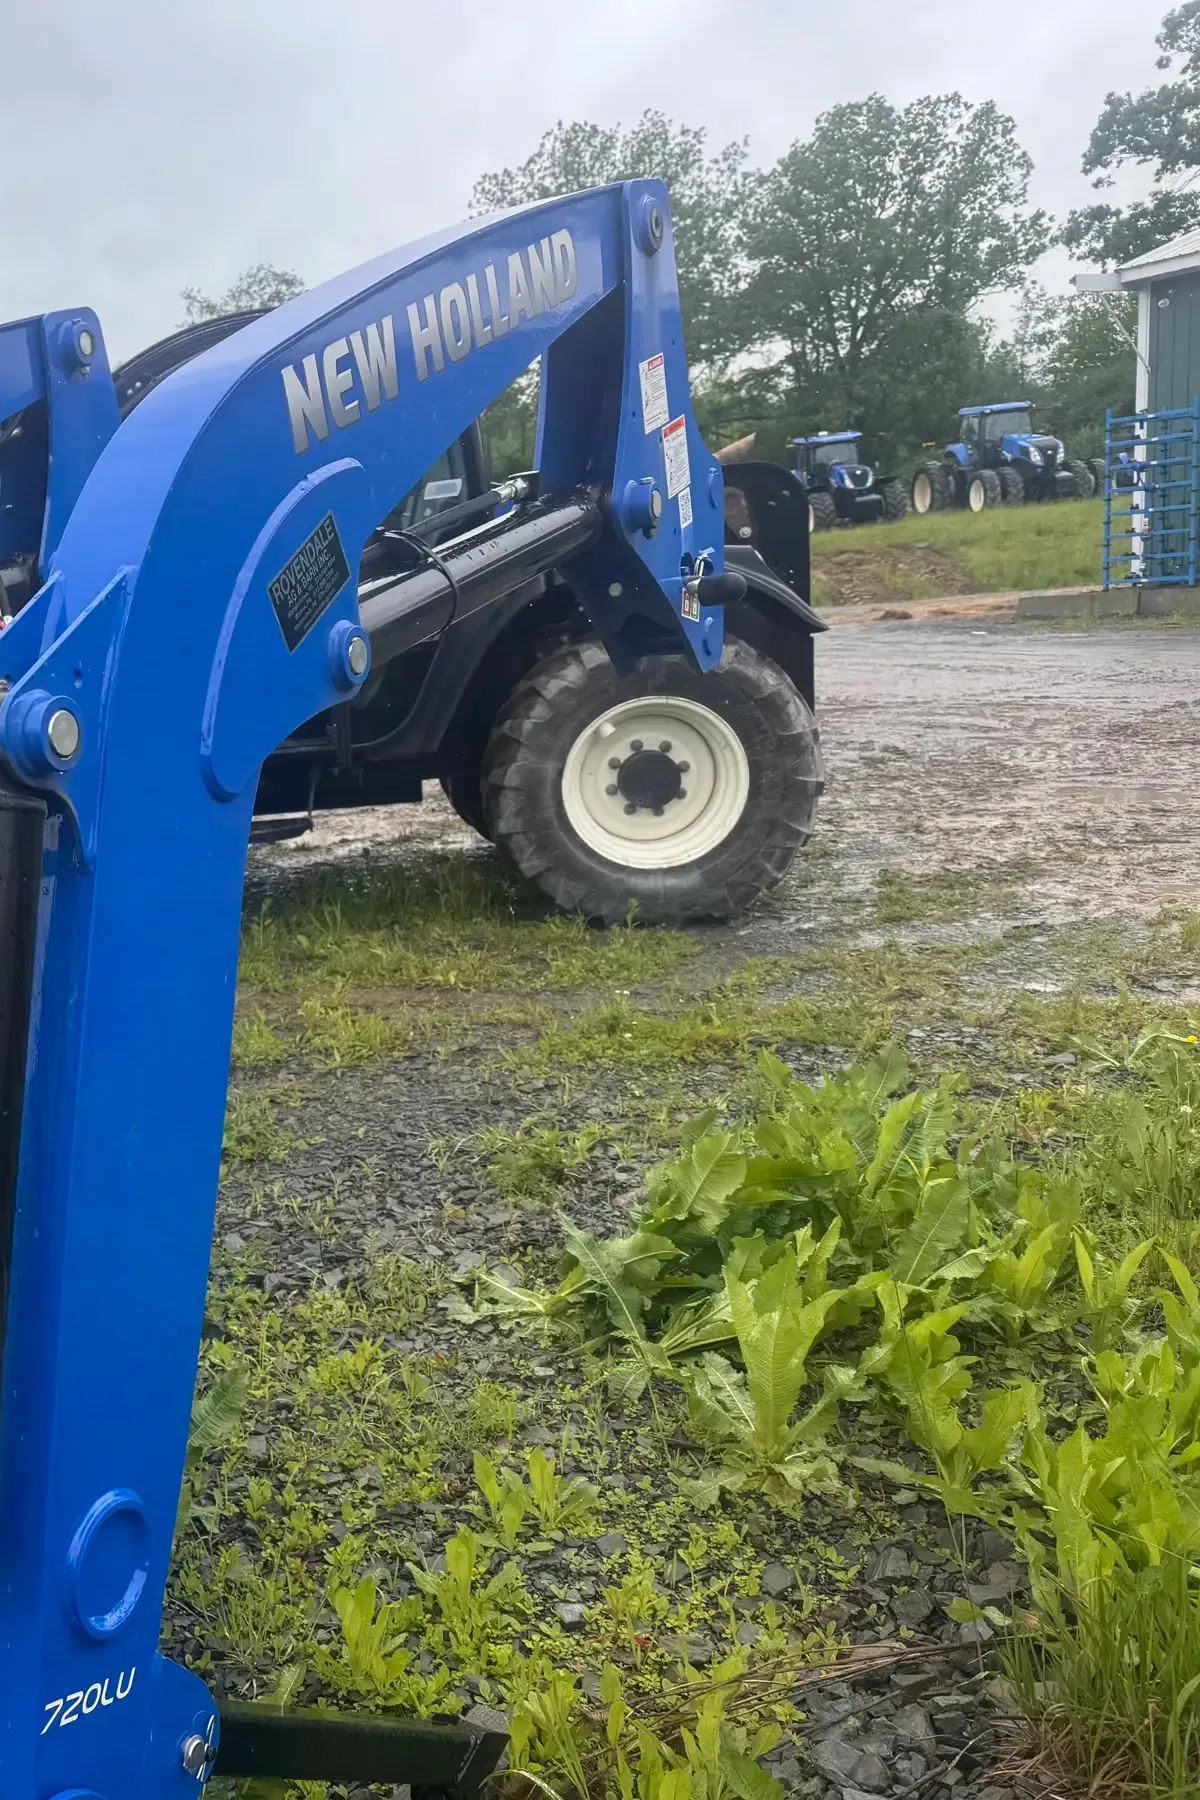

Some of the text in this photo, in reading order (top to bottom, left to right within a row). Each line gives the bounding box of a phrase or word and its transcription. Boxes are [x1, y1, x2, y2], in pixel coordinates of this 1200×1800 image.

[281, 229, 577, 455] NEW HOLLAND
[272, 518, 335, 605] ROVENDALE
[286, 588, 297, 608] AG
[296, 581, 302, 596] &
[301, 560, 318, 589] BARN
[316, 548, 332, 568] INC.
[40, 1666, 136, 1736] 720LU
